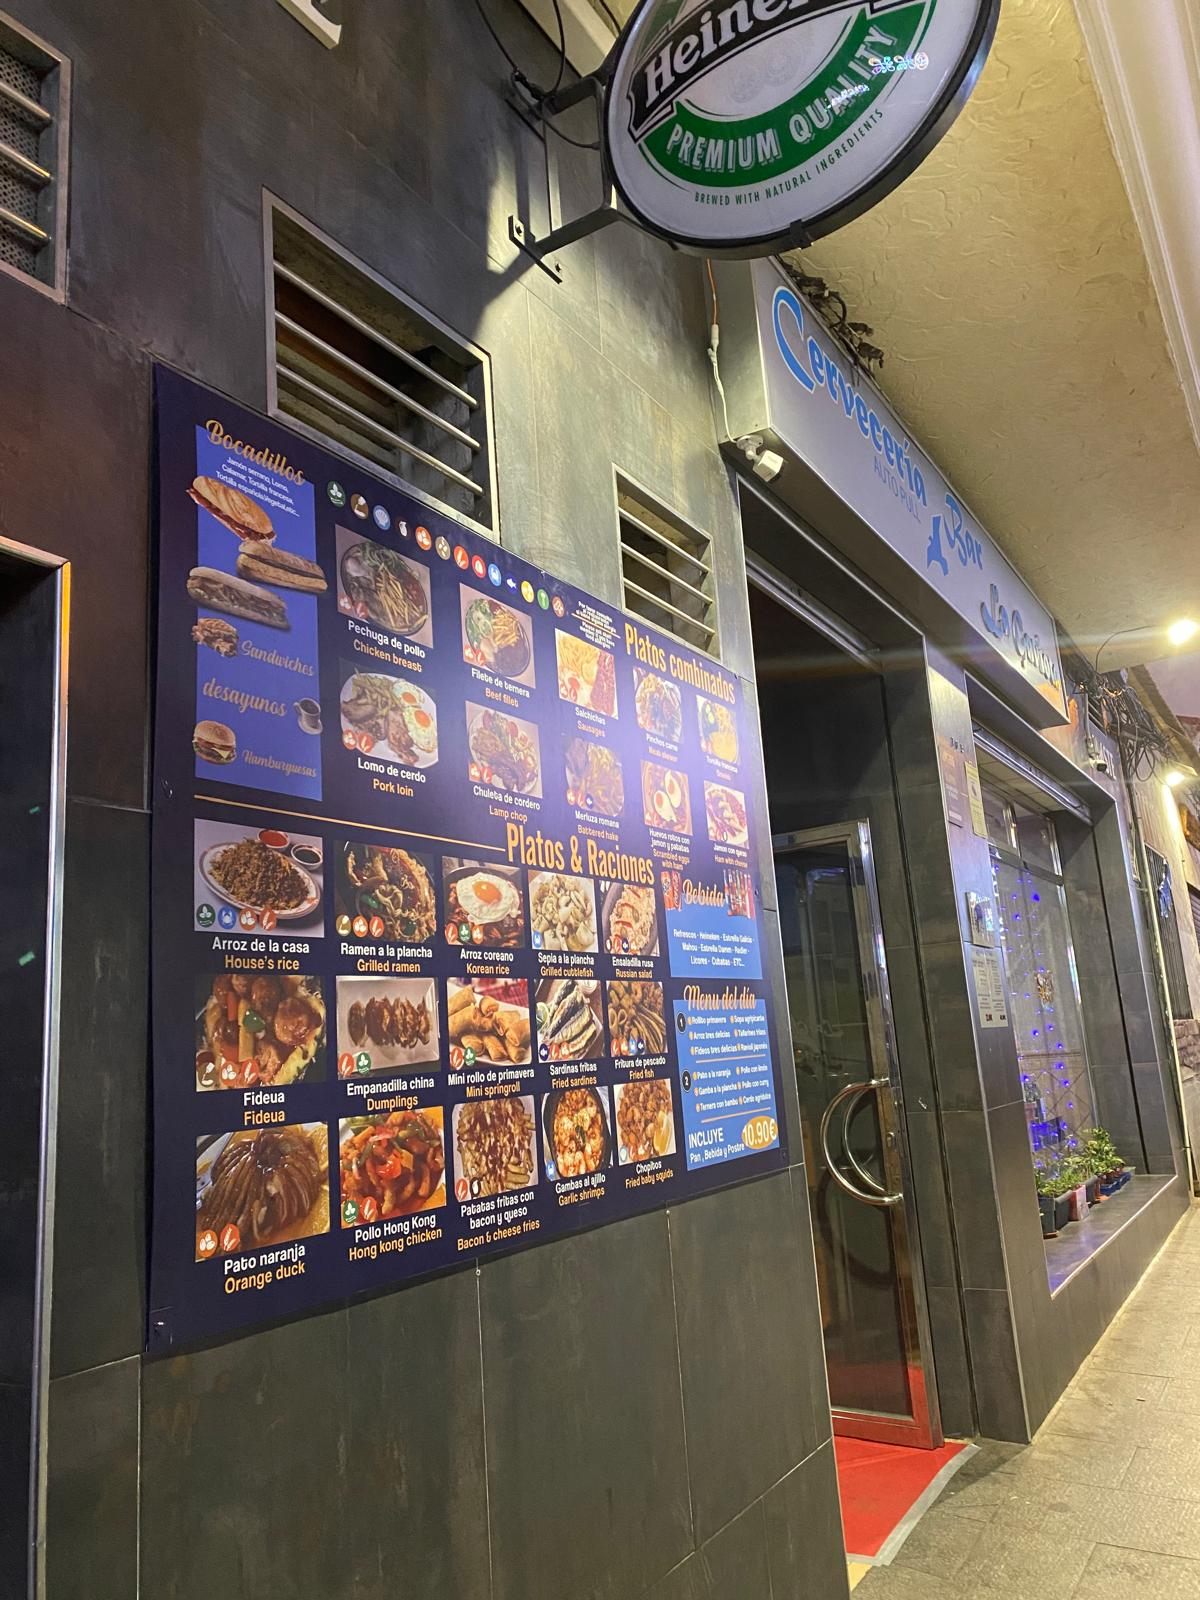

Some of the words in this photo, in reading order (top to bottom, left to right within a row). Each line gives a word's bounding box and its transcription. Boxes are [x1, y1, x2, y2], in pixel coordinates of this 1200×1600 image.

[666, 123, 780, 173] PREMIUM
[789, 25, 896, 144] QUALITY
[694, 190, 730, 206] BREWED
[735, 191, 760, 205] WITH
[765, 171, 812, 199] NATURAL
[815, 108, 884, 174] INGREDIENTS
[772, 286, 928, 507] Cervecería
[944, 492, 984, 571] Bar
[205, 419, 305, 486] Bocadillos
[216, 471, 237, 486] Tortilla
[248, 476, 267, 491] Tortilla
[874, 456, 897, 496] AUTO
[348, 620, 389, 645] Pechuga
[390, 635, 402, 650] de
[403, 641, 425, 658] pollo
[241, 640, 314, 675] Sandwiches
[353, 639, 391, 662] Chicken
[392, 651, 422, 672] breast
[624, 622, 666, 673] Platos
[669, 653, 736, 705] combinados
[471, 668, 492, 684] Filete
[493, 675, 503, 687] de
[504, 678, 529, 697] ternera
[202, 677, 288, 716] desayunos
[485, 687, 501, 701] Beef
[575, 706, 605, 725] Salchichas
[577, 720, 605, 737] Sausages
[242, 749, 317, 777] Hamburguesas
[357, 757, 384, 774] Lomo
[386, 763, 399, 776] de
[400, 767, 426, 783] cerdo
[373, 778, 394, 793] Pork
[396, 783, 413, 796] loin
[472, 784, 502, 801] Chuleta
[503, 792, 512, 804] de
[514, 795, 540, 810] cordero
[489, 805, 509, 820] Lamp
[510, 810, 527, 822] chop
[575, 809, 597, 824] Merluza
[598, 815, 619, 828] romana
[577, 823, 603, 838] Battered
[604, 829, 618, 841] hake
[649, 828, 666, 839] Huevos
[506, 822, 564, 869] Platos
[570, 834, 583, 872] &
[587, 839, 654, 884] Raciones
[682, 878, 725, 907] Bebida
[212, 936, 246, 950] Arroz
[250, 938, 265, 951] de
[268, 939, 278, 952] la
[282, 941, 309, 953] casa
[340, 942, 375, 956] Ramen
[377, 946, 384, 955] a
[386, 945, 394, 957] la
[396, 946, 432, 959] plancha
[277, 957, 299, 969] rice
[460, 948, 481, 960] Arroz
[482, 951, 513, 962] coreano
[538, 952, 556, 965] Sepia
[563, 954, 569, 964] la
[570, 955, 594, 966] plancha
[612, 956, 641, 968] Ensaladilla
[357, 958, 389, 972] Grilled
[391, 961, 420, 972] ramen
[466, 962, 493, 974] Korean
[495, 964, 509, 974] rice
[540, 966, 561, 976] Grilled
[563, 966, 593, 976] cuttlefish
[615, 968, 636, 977] Russian
[637, 969, 652, 978] salad
[684, 984, 720, 1011] Menu
[721, 985, 737, 1009] del
[549, 1063, 578, 1075] Sardinas
[579, 1061, 596, 1072] fritas
[614, 1059, 634, 1068] Fritura
[635, 1058, 641, 1067] de
[642, 1056, 665, 1068] pescado
[448, 1072, 464, 1085] Mini
[465, 1071, 484, 1083] rollo
[486, 1070, 496, 1081] de
[498, 1068, 534, 1082] primavera
[552, 1078, 569, 1088] Fried
[570, 1075, 596, 1086] sardines
[629, 1070, 644, 1079] Fried
[645, 1069, 654, 1078] fish
[347, 1078, 407, 1097] Empanadilla
[409, 1076, 434, 1090] china
[466, 1085, 482, 1097] Mini
[484, 1081, 520, 1097] springroll
[243, 1091, 284, 1106] Fideua
[367, 1095, 418, 1111] Dumplings
[244, 1109, 285, 1125] Fideua
[688, 1127, 724, 1148] INCLUYE
[742, 1118, 777, 1146] 10.90€
[704, 1147, 722, 1160] Bebida
[727, 1143, 744, 1153] Postre
[635, 1160, 662, 1176] Chopitos
[555, 1178, 583, 1194] Gambas
[584, 1177, 589, 1187] al
[590, 1173, 605, 1187] ajillo
[625, 1176, 640, 1188] Fried
[641, 1172, 654, 1186] baby
[655, 1168, 673, 1183] squids
[460, 1200, 495, 1217] Patatas
[496, 1194, 518, 1209] fritas
[519, 1190, 534, 1202] con
[558, 1192, 578, 1206] Garlic
[579, 1186, 604, 1201] shrimps
[355, 1226, 381, 1242] Pollo
[383, 1219, 409, 1236] Hong
[411, 1213, 436, 1230] Kong
[469, 1214, 495, 1230] bacon
[497, 1213, 502, 1224] y
[503, 1206, 527, 1222] queso
[349, 1244, 377, 1261] Hong
[379, 1236, 404, 1253] kong
[405, 1227, 442, 1246] chicken
[457, 1234, 484, 1251] Bacon
[493, 1225, 521, 1242] cheese
[522, 1218, 540, 1232] fries
[224, 1255, 256, 1274] Pato
[260, 1243, 305, 1262] naranja
[224, 1270, 272, 1293] Orange
[275, 1260, 305, 1279] duck
